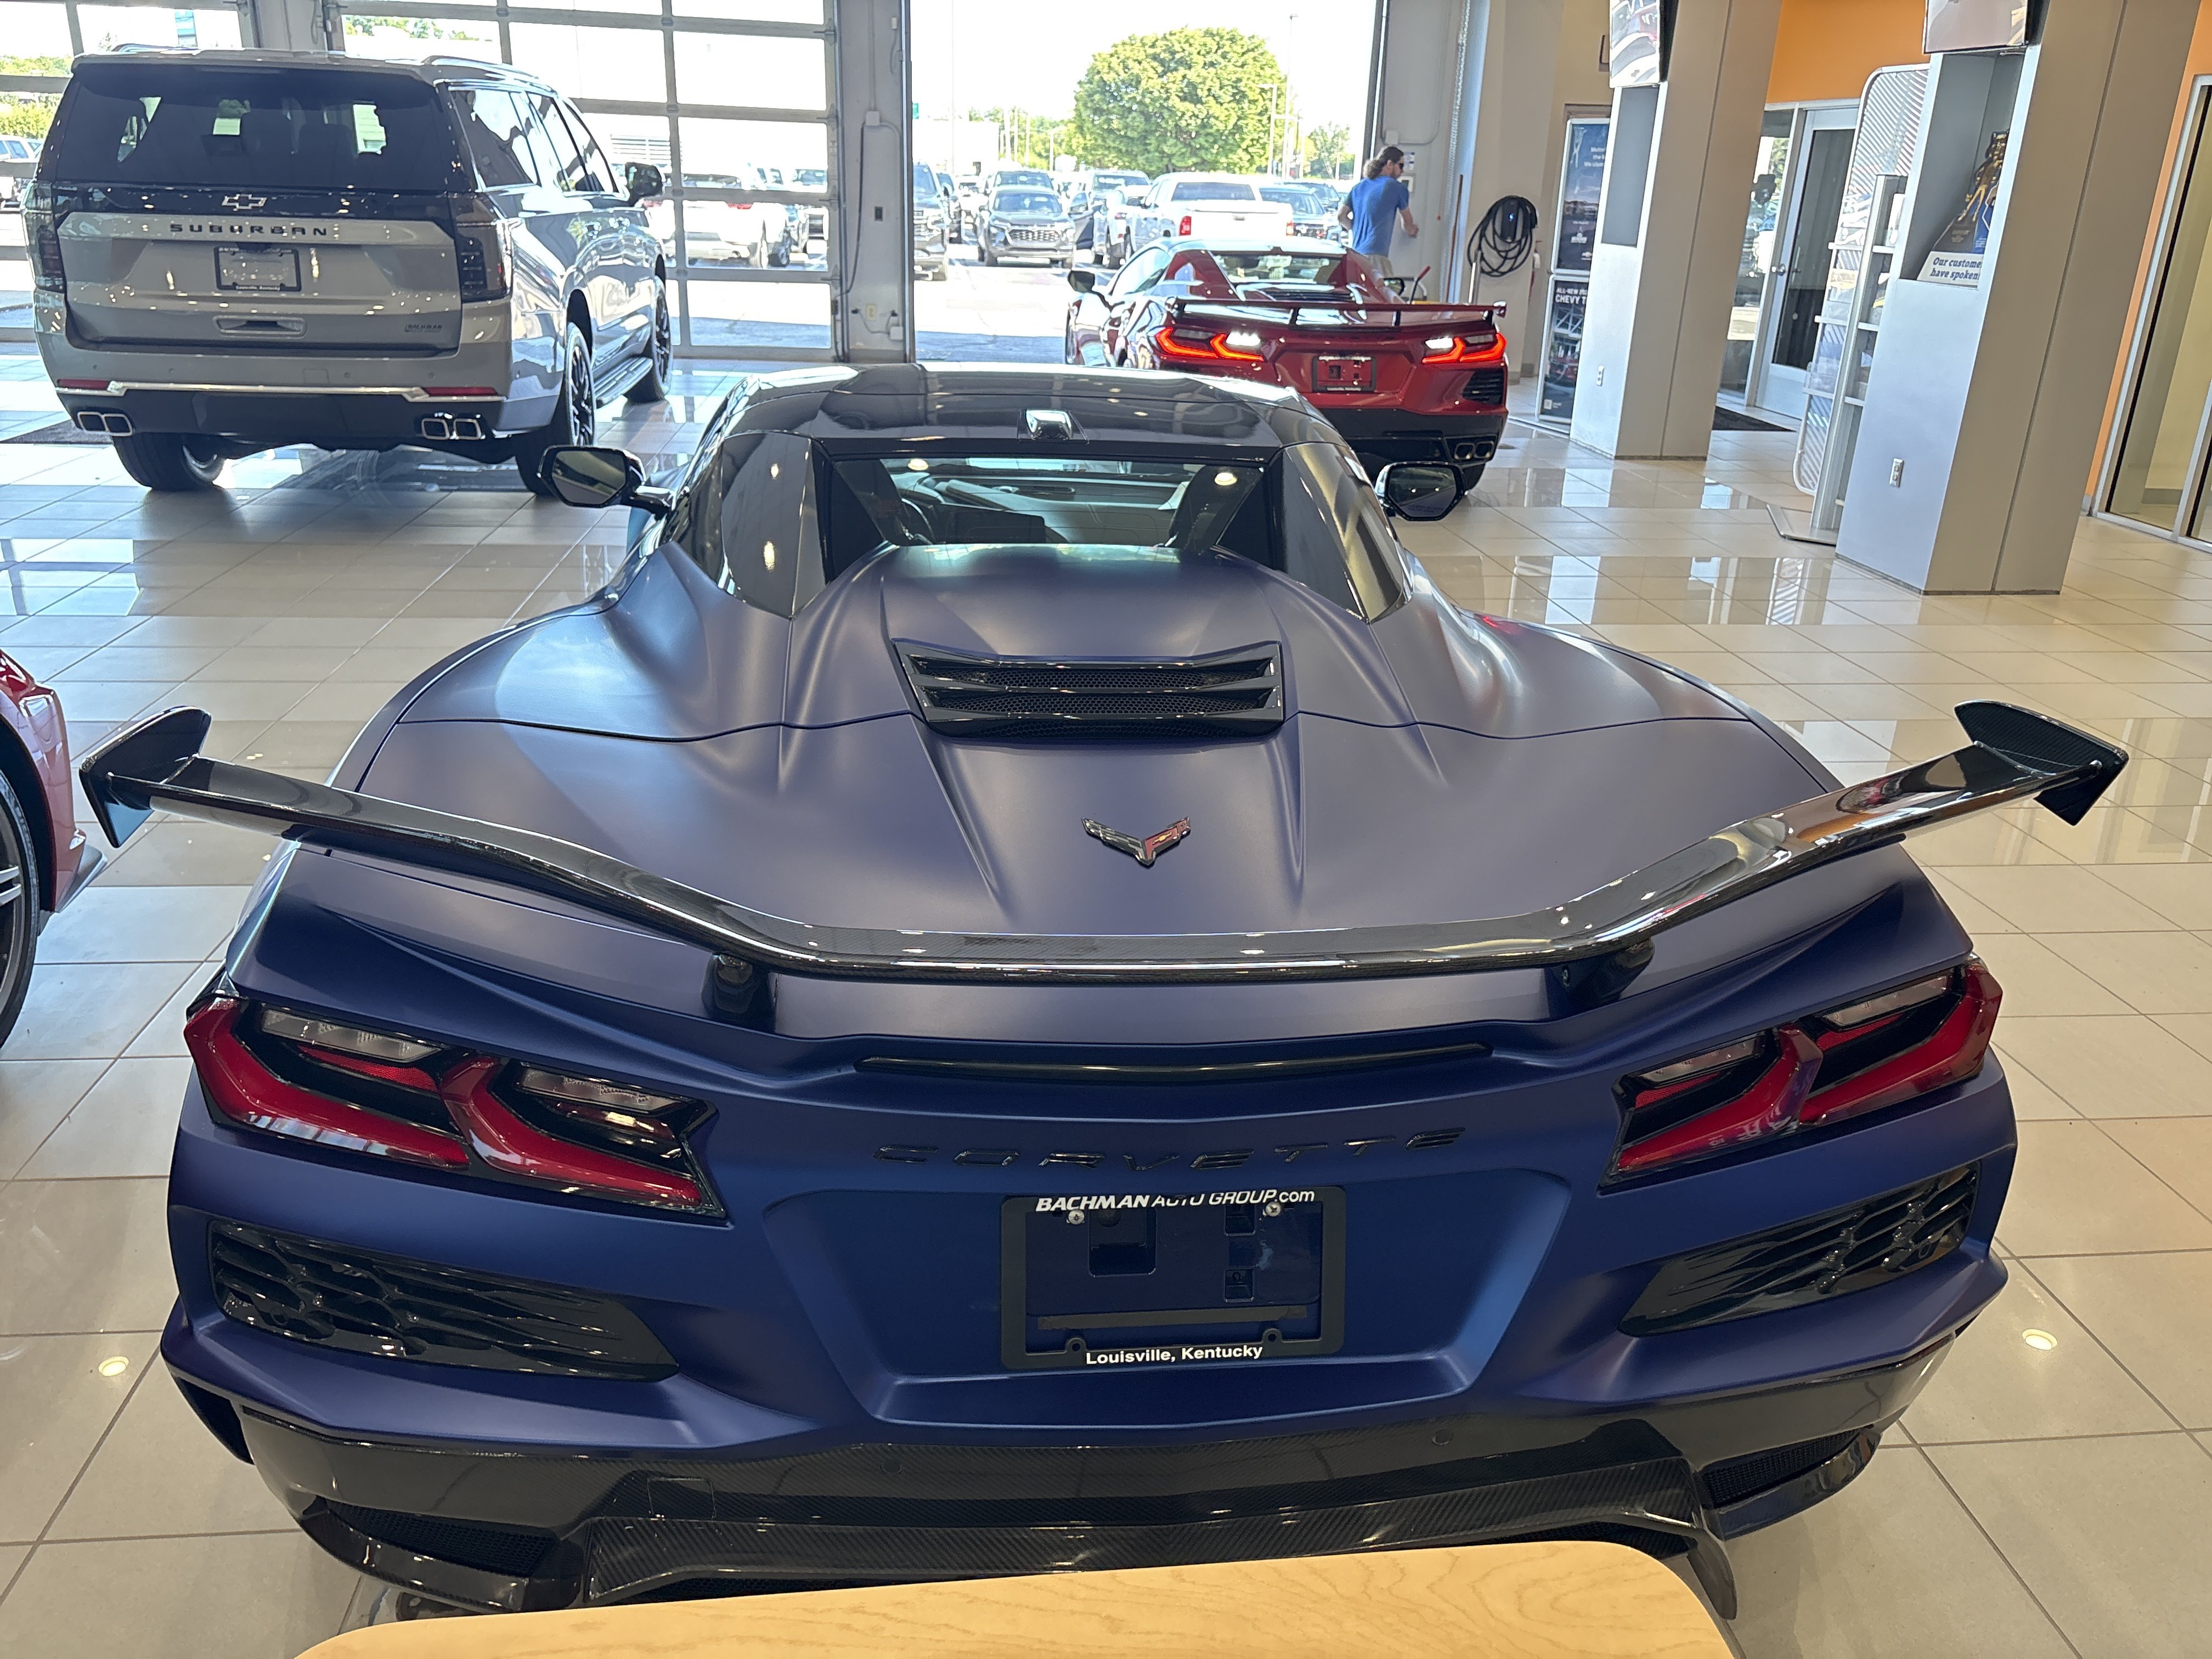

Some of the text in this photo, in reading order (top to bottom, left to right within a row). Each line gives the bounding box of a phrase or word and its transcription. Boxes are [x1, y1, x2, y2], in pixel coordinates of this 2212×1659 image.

[170, 224, 327, 236] SUBURBAN
[1933, 257, 1982, 268] Our custome
[1930, 268, 1949, 278] have
[1555, 294, 1580, 304] CHEVY
[871, 1126, 1466, 1171] CORVETTE
[1036, 1194, 1150, 1211] BACHMAN
[1086, 1345, 1263, 1364] Louisville, Kentucky
